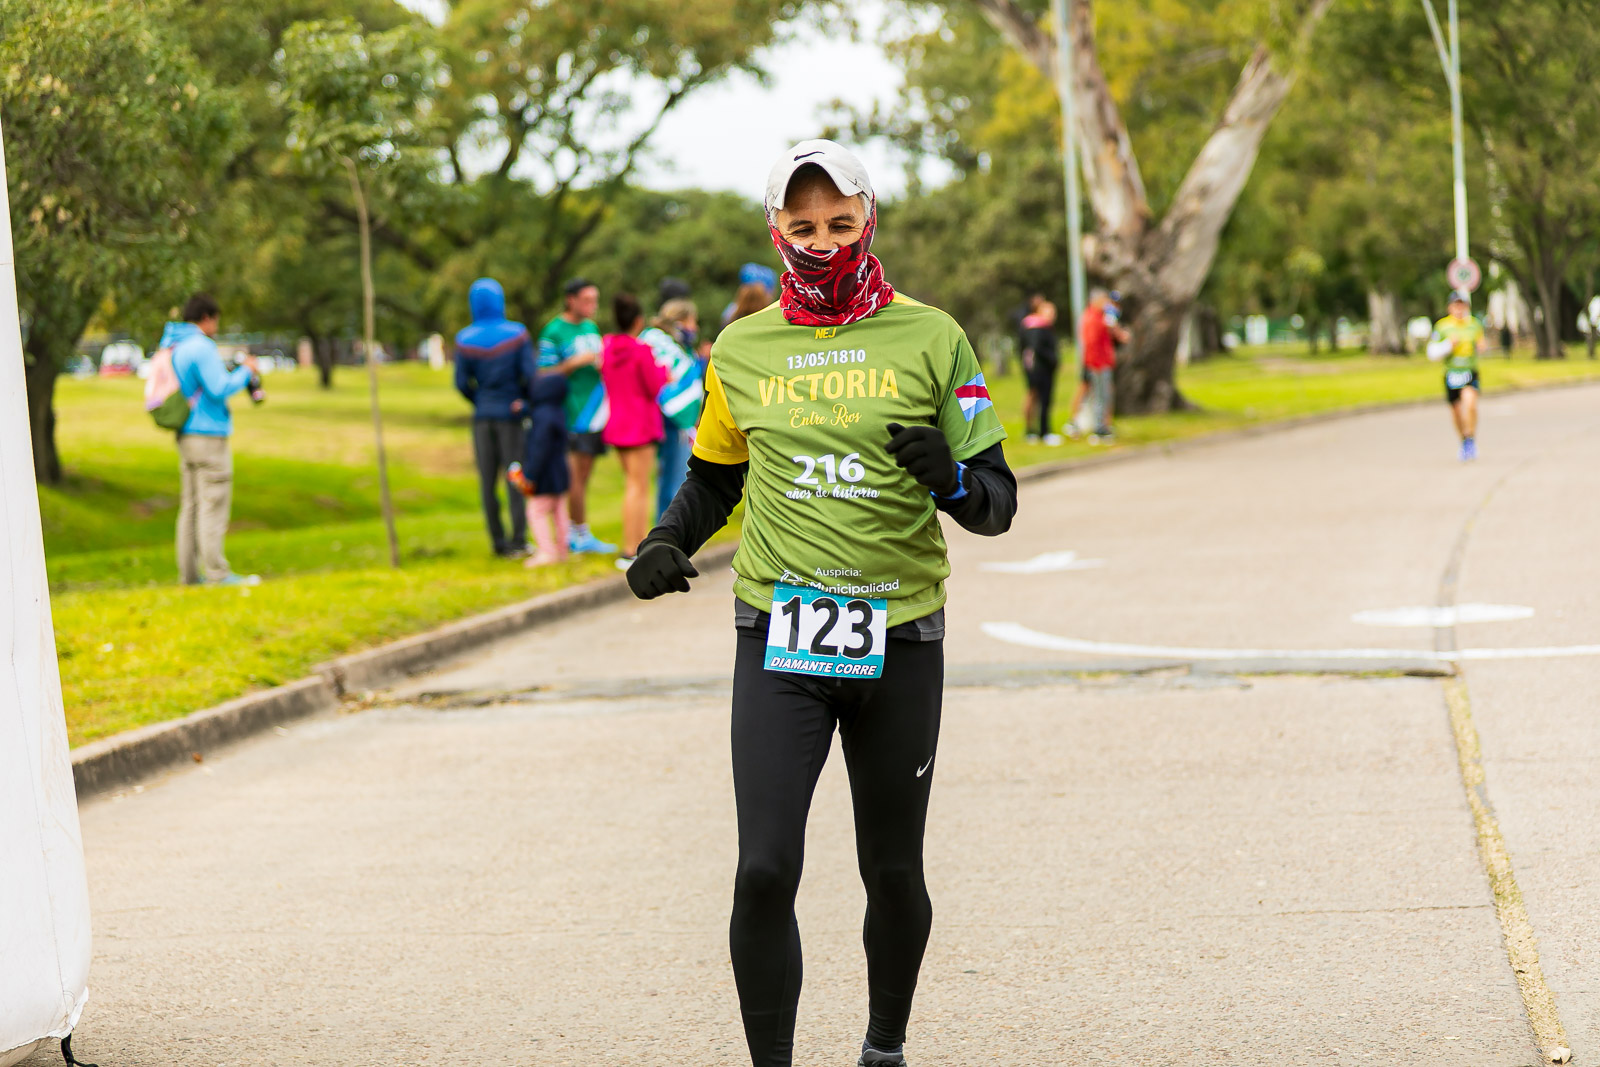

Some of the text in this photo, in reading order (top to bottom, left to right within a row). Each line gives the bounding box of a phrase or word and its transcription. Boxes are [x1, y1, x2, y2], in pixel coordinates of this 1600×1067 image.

[815, 327, 836, 340] NEJ
[787, 349, 865, 369] 13/05/1810
[758, 368, 899, 406] VICTORIA
[788, 407, 827, 429] Entre
[792, 452, 866, 485] 216
[785, 484, 880, 499] años de historia
[815, 567, 861, 578] Auspicia:
[781, 595, 873, 660] 123
[770, 656, 877, 676] DIAMANTE CORRE
